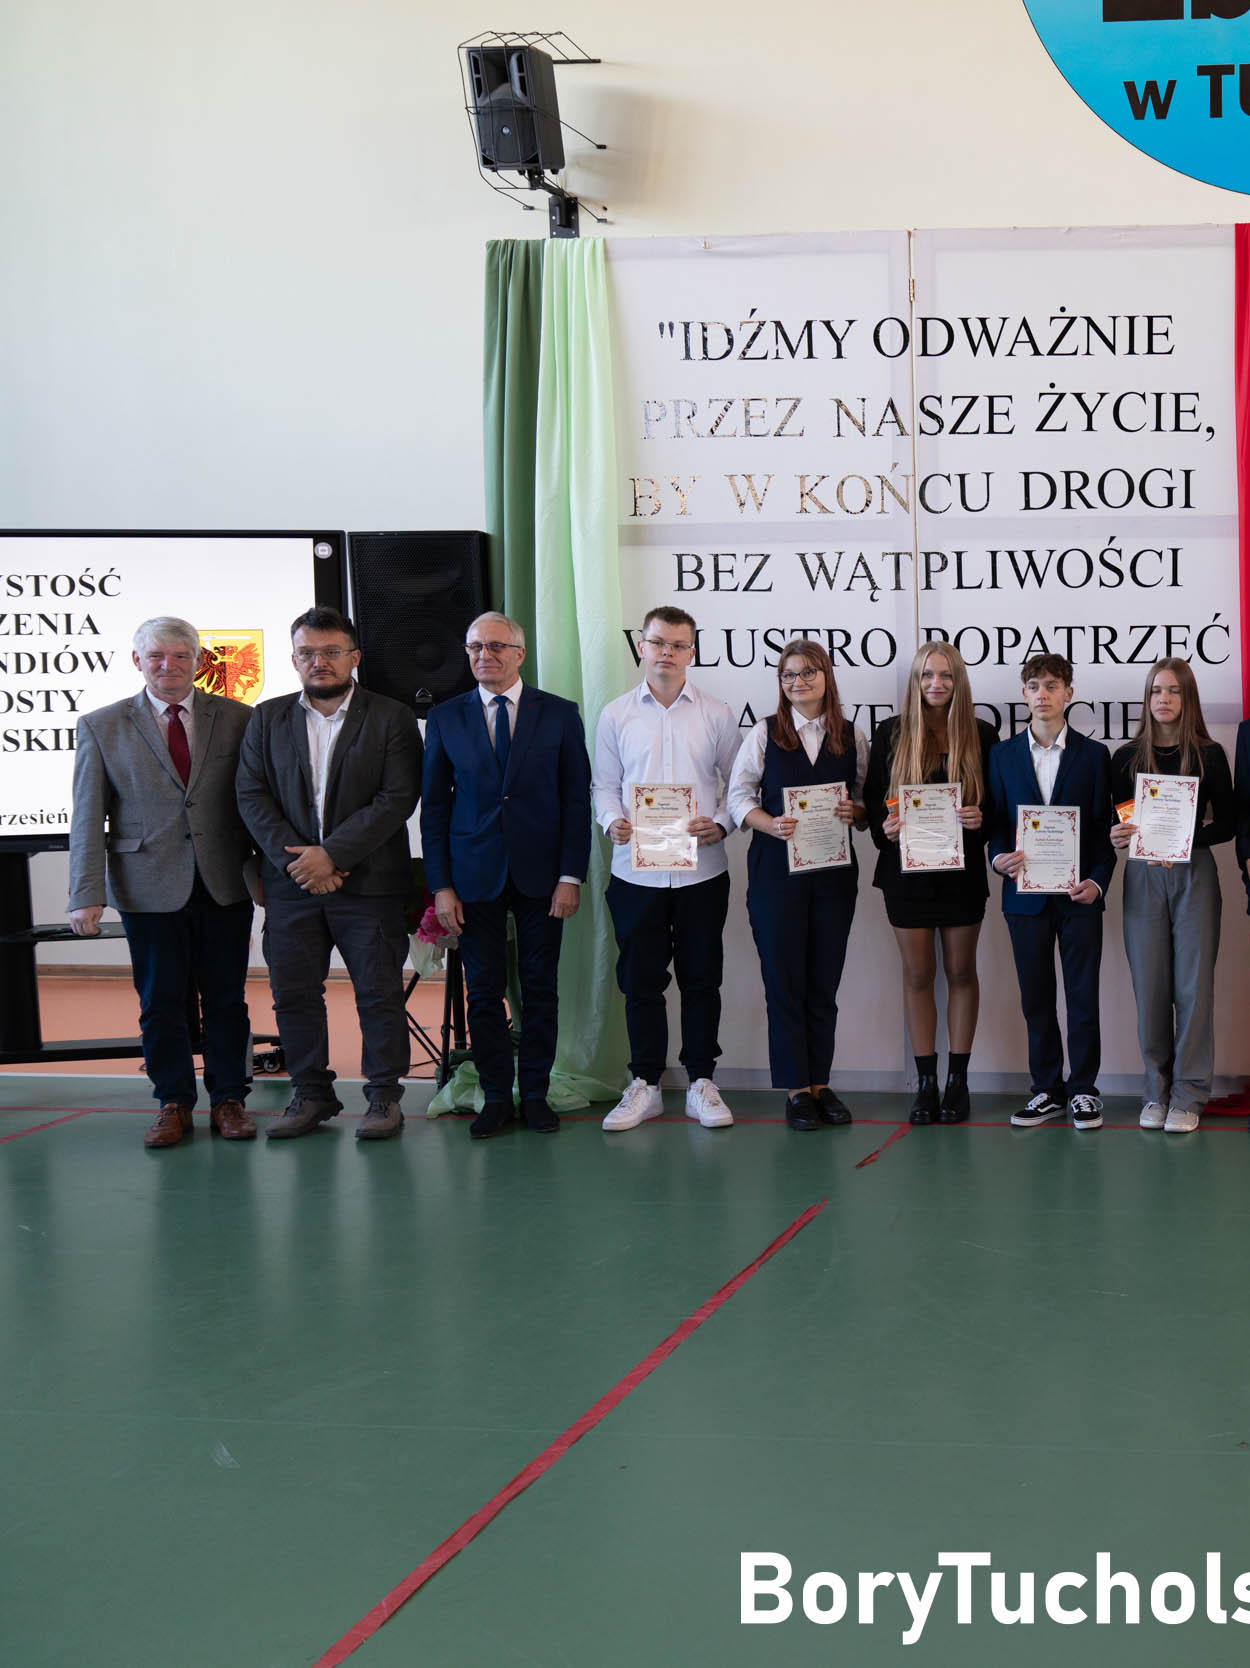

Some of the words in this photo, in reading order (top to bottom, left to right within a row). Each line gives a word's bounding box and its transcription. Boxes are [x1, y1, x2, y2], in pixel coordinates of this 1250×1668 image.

[1123, 79, 1177, 120] w
[658, 308, 858, 361] "IDŹMY
[872, 305, 1175, 358] ODWAŻNIE
[640, 397, 805, 440] PRZEZ
[829, 394, 1016, 438] NASZE
[1035, 382, 1215, 442] ŻYCIE,
[628, 476, 699, 517] BY
[723, 473, 775, 514] W
[794, 461, 996, 515] KOŃCU
[1018, 467, 1197, 512] DROGI
[0, 567, 122, 598] STOŚĆ
[671, 552, 774, 593] BEZ
[795, 536, 1184, 603] WĄTPLIWOŚCI
